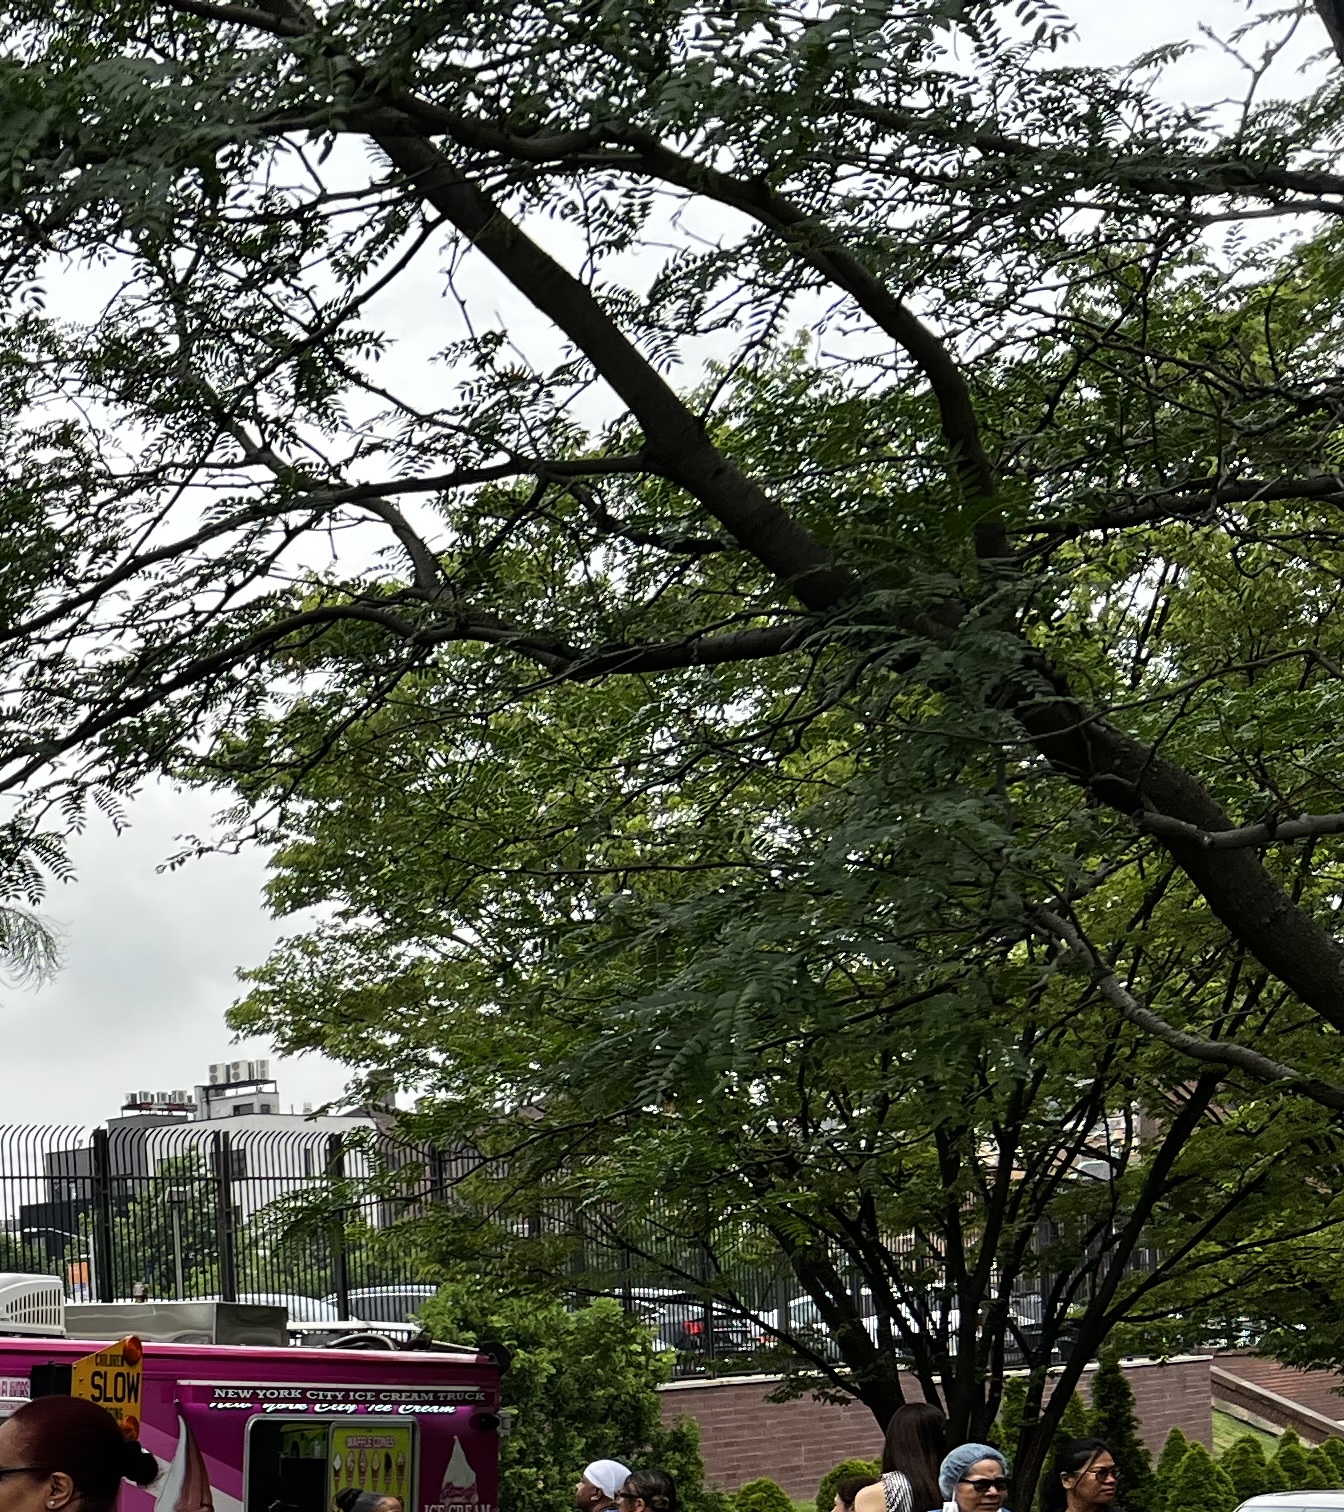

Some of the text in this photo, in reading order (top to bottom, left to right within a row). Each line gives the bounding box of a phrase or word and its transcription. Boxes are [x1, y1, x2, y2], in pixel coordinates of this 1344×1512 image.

[91, 1370, 141, 1404] SLOW
[214, 1388, 486, 1401] NEW YORK CITY ICE CREAM TRUCK
